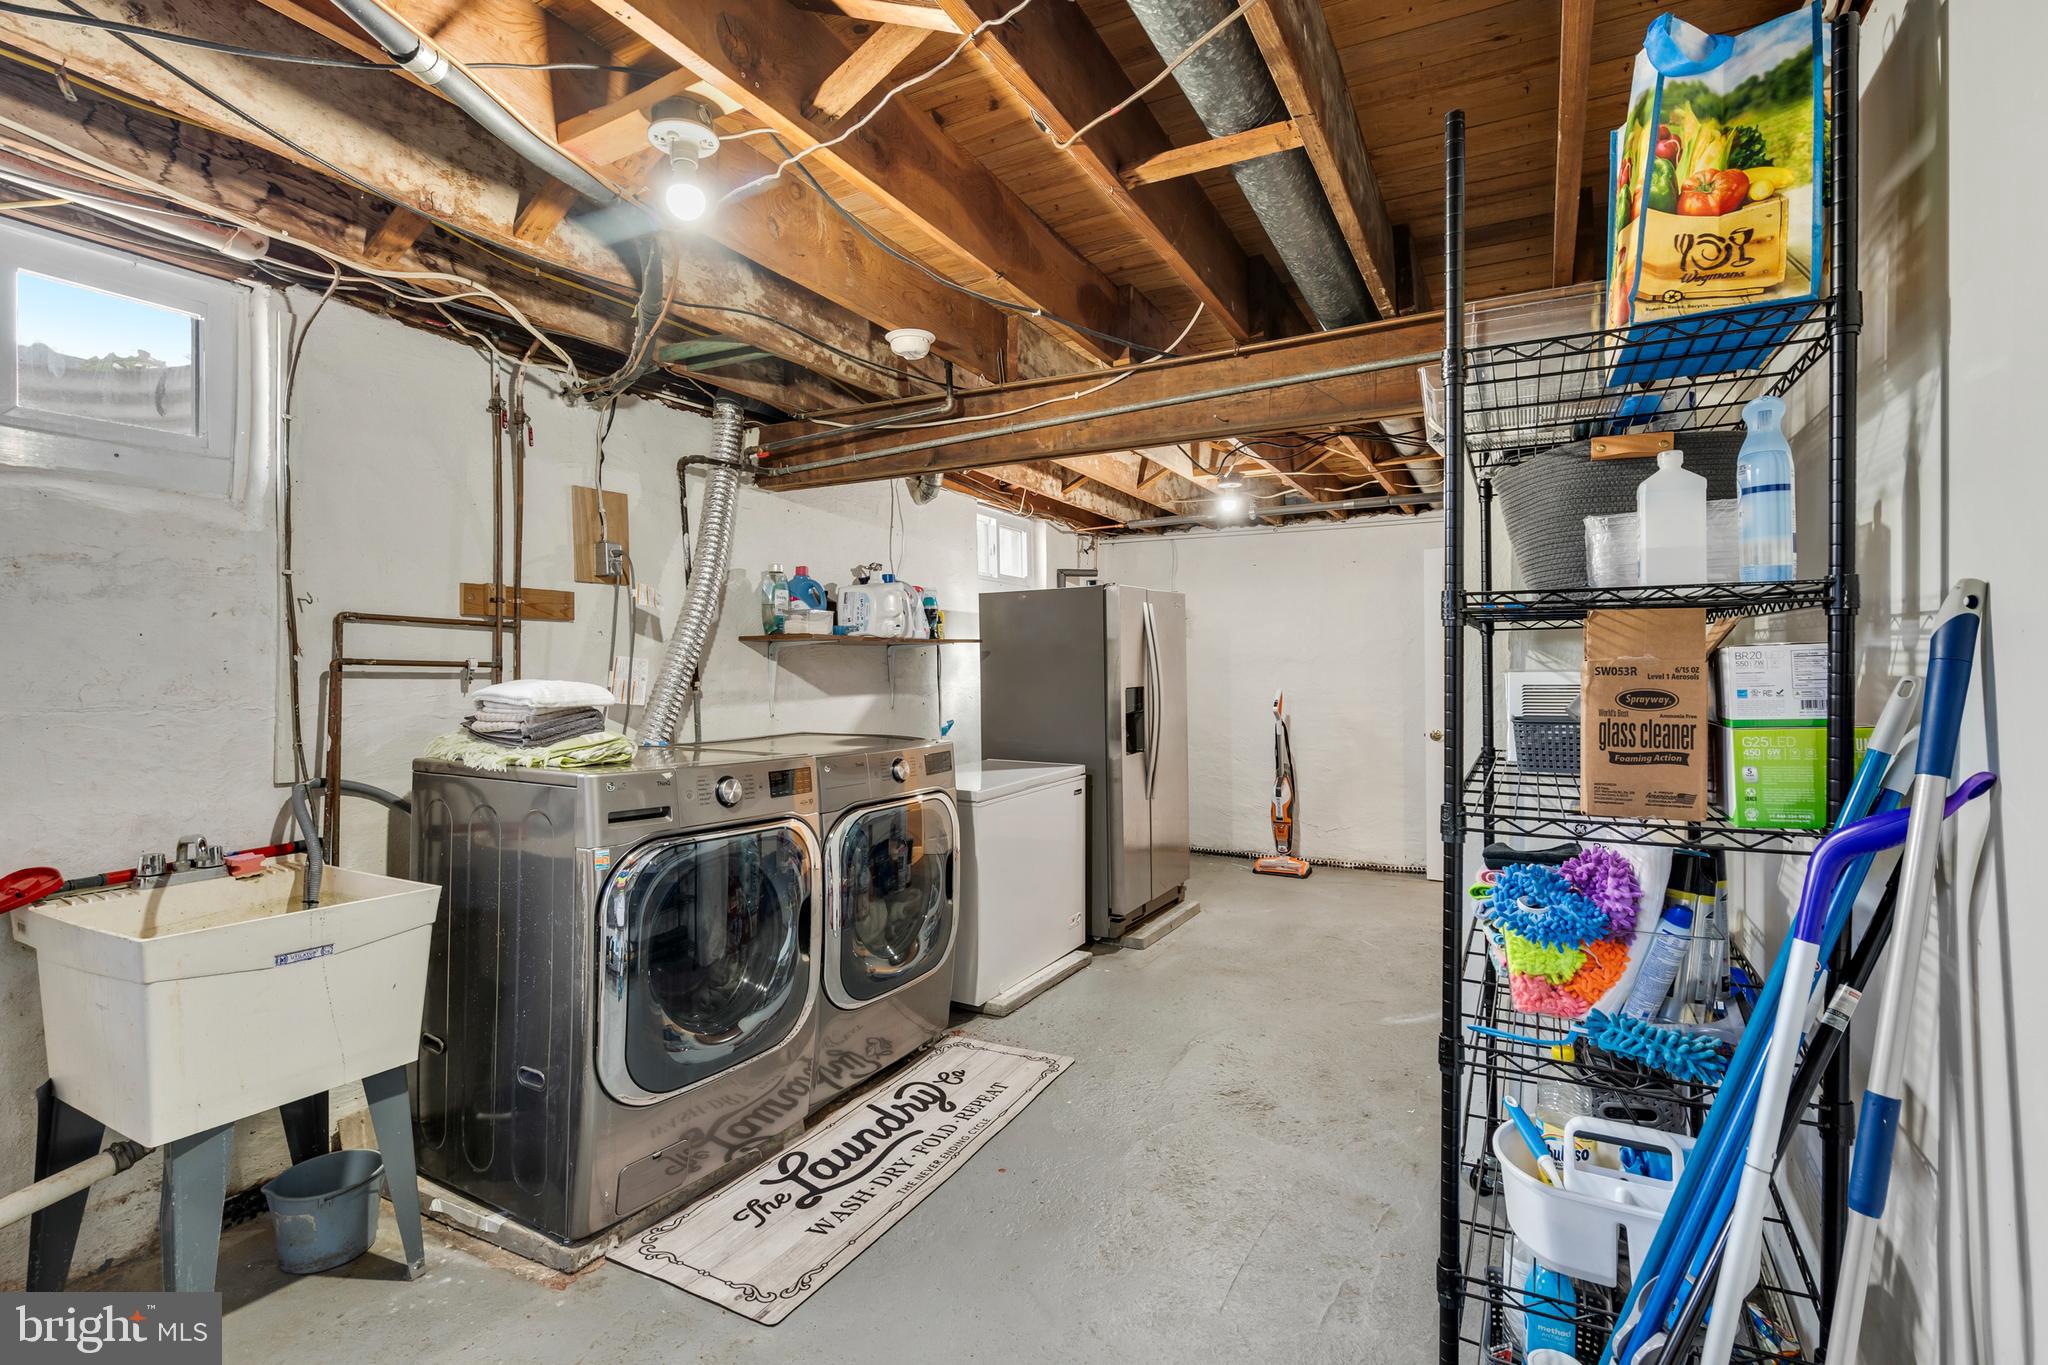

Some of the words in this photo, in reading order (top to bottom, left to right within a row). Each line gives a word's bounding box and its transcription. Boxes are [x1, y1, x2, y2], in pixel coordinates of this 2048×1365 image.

[1680, 270, 1746, 286] Wegmans
[1594, 666, 1638, 677] SW053R
[1625, 694, 1670, 705] Sprayway
[1599, 718, 1636, 751] glass
[1640, 719, 1697, 750] cleaner
[1614, 754, 1652, 764] Foaming
[1653, 754, 1682, 762] Action
[759, 1081, 957, 1209] Laundry
[896, 1176, 917, 1195] THE
[914, 1159, 944, 1181] NEVER
[940, 1135, 971, 1160] ENDING
[967, 1117, 992, 1135] CYCLE
[805, 1189, 878, 1236] WASH
[869, 1157, 916, 1188] DRY
[911, 1123, 959, 1156] FOLD
[953, 1081, 1009, 1122] REPEAT
[732, 1193, 792, 1229] The
[1537, 1324, 1572, 1338] method
